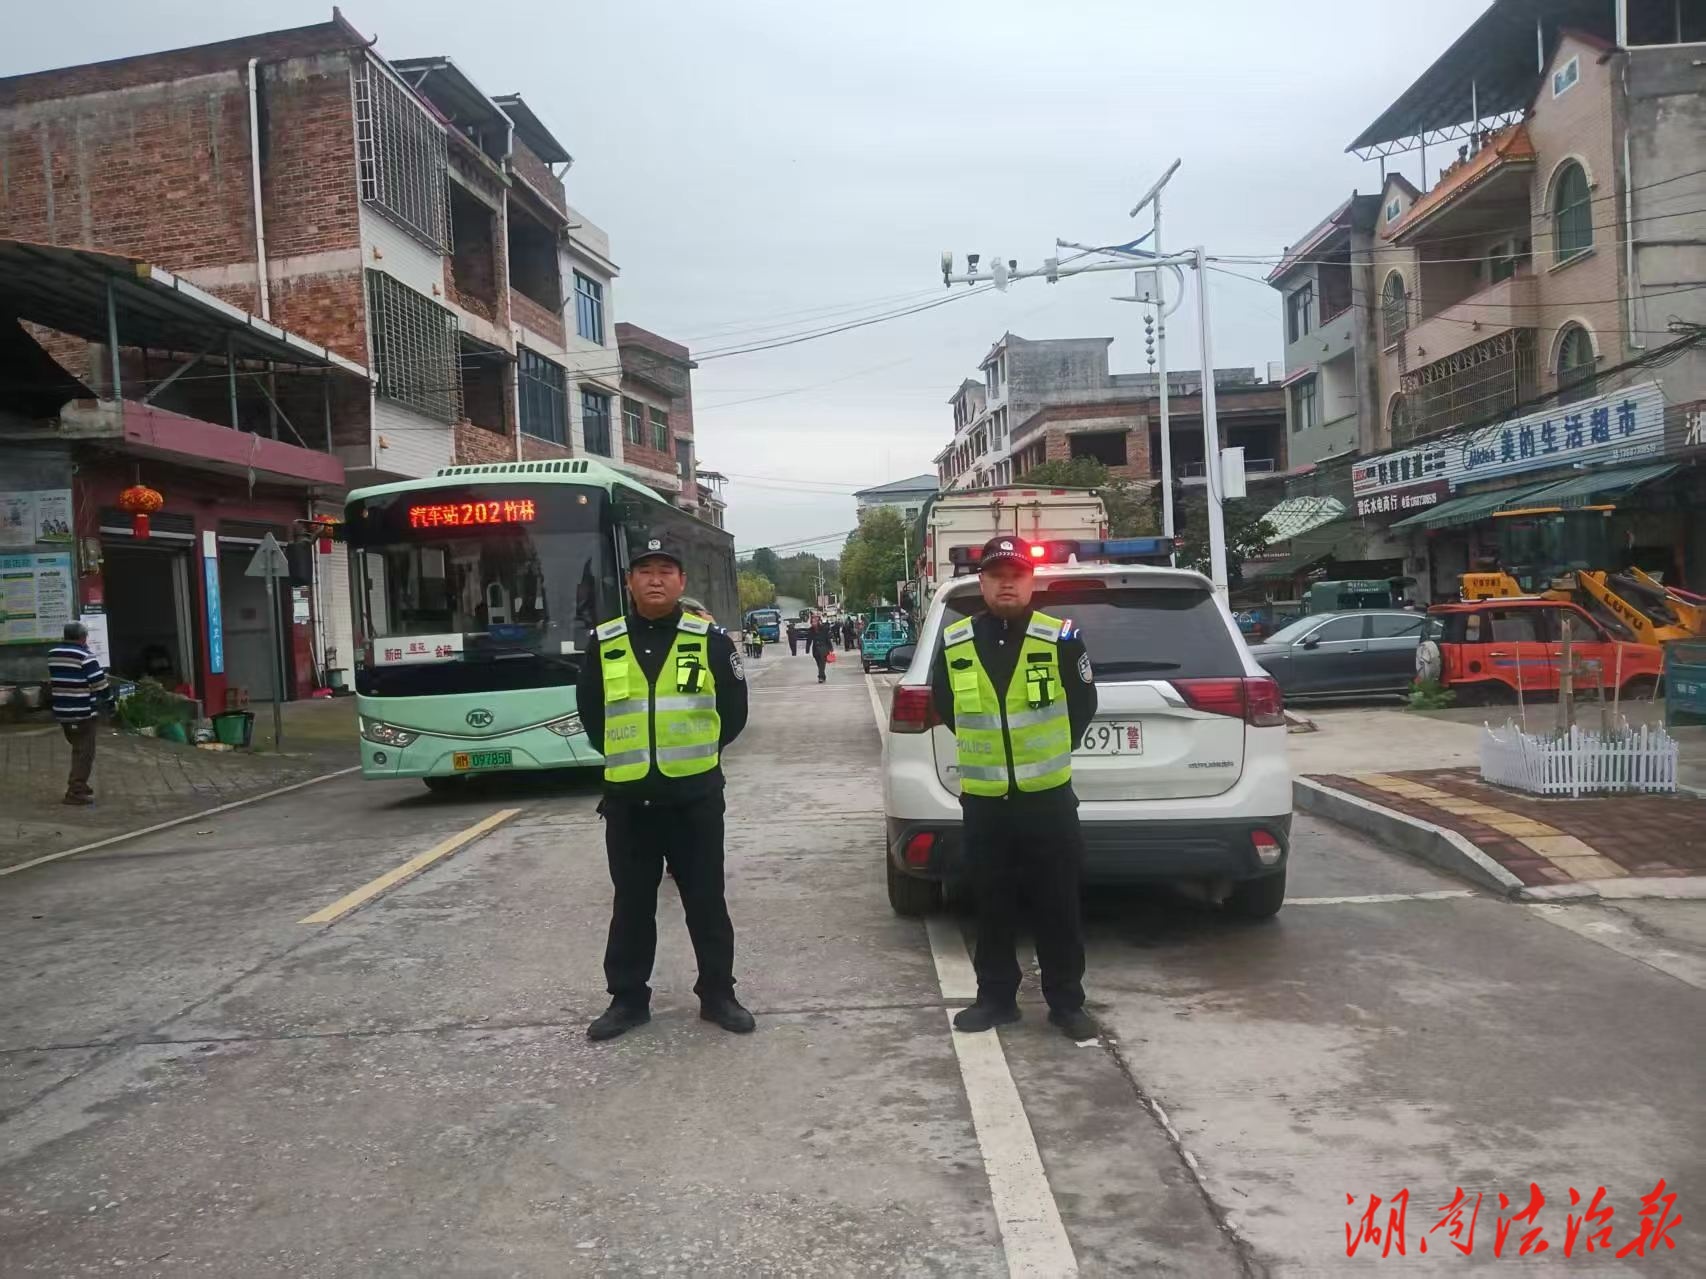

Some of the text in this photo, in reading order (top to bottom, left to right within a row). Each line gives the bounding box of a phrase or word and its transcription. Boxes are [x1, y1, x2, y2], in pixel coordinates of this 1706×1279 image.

[1500, 400, 1637, 463] 美的生活超市
[385, 648, 402, 661] 新田
